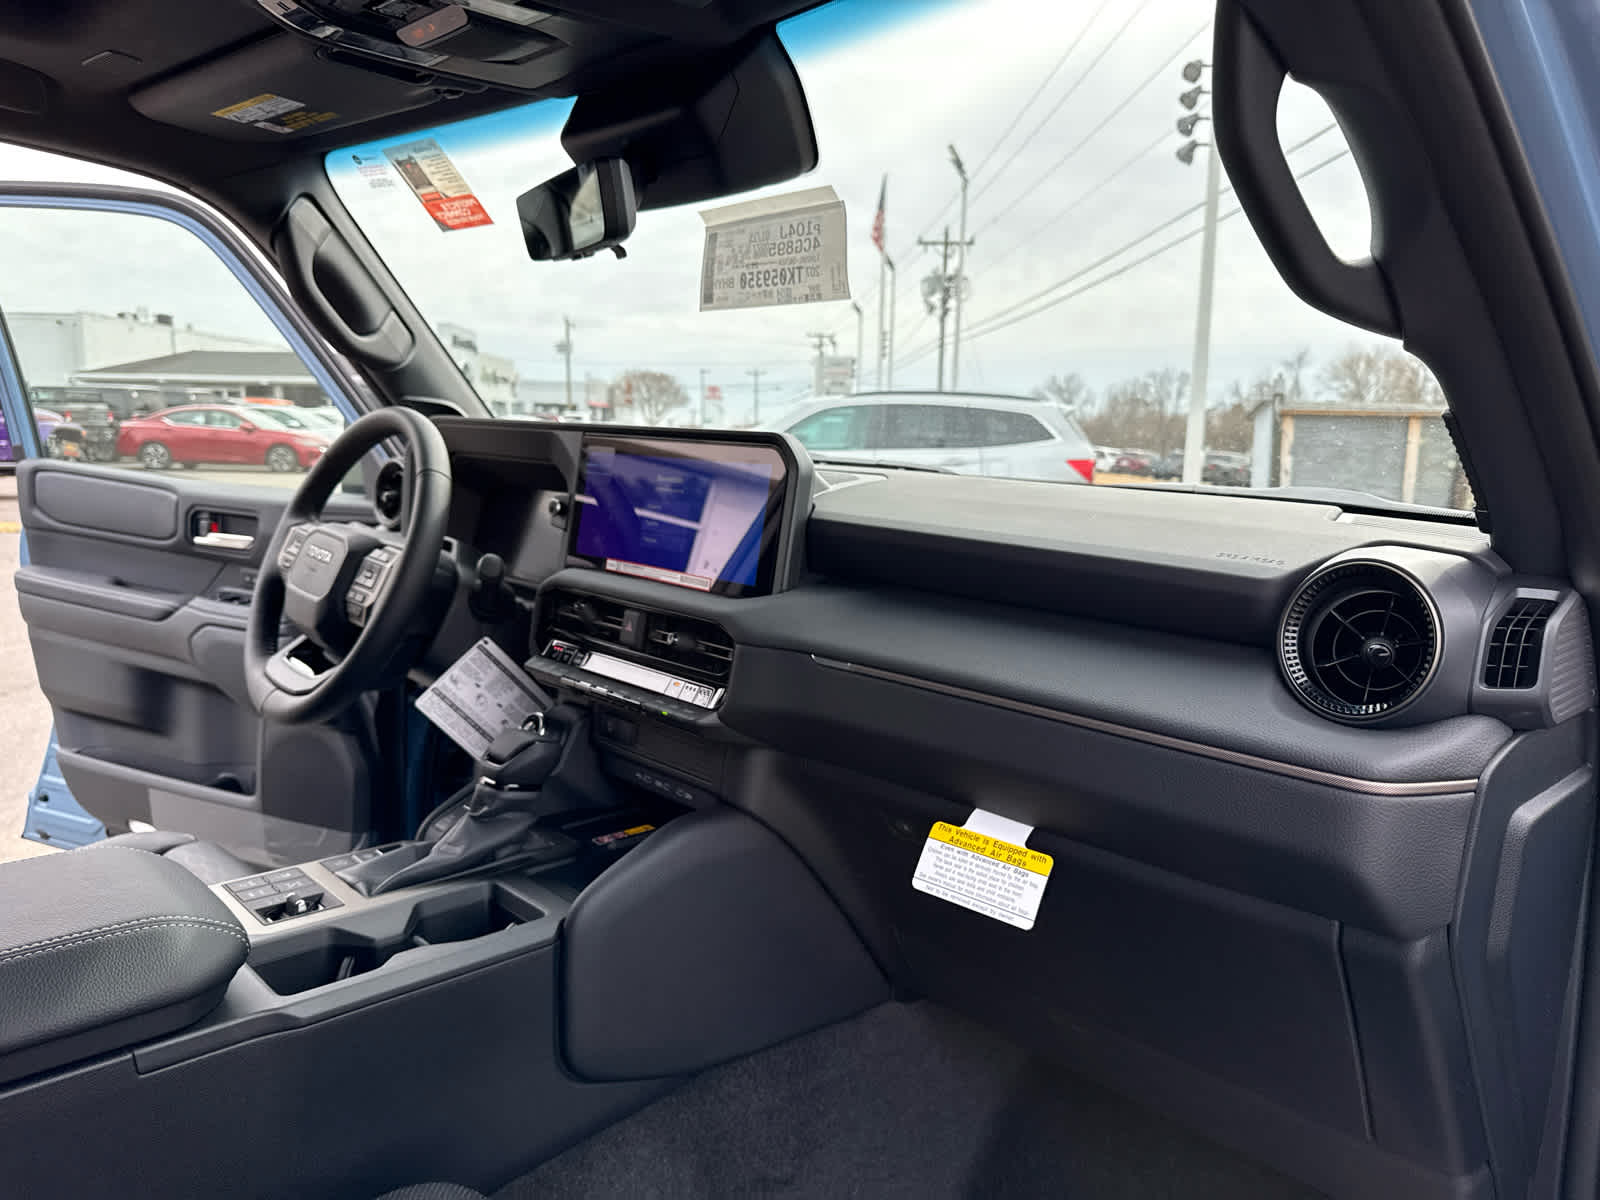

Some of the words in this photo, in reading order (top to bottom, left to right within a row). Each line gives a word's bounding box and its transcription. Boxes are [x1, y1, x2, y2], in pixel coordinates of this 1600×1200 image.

[938, 824, 952, 834] This
[955, 828, 980, 843] Vehicle
[992, 840, 1028, 858] Equipped
[1030, 853, 1048, 864] with
[949, 836, 987, 853] Advanced
[989, 850, 1003, 859] Air
[1006, 855, 1027, 867] Bags
